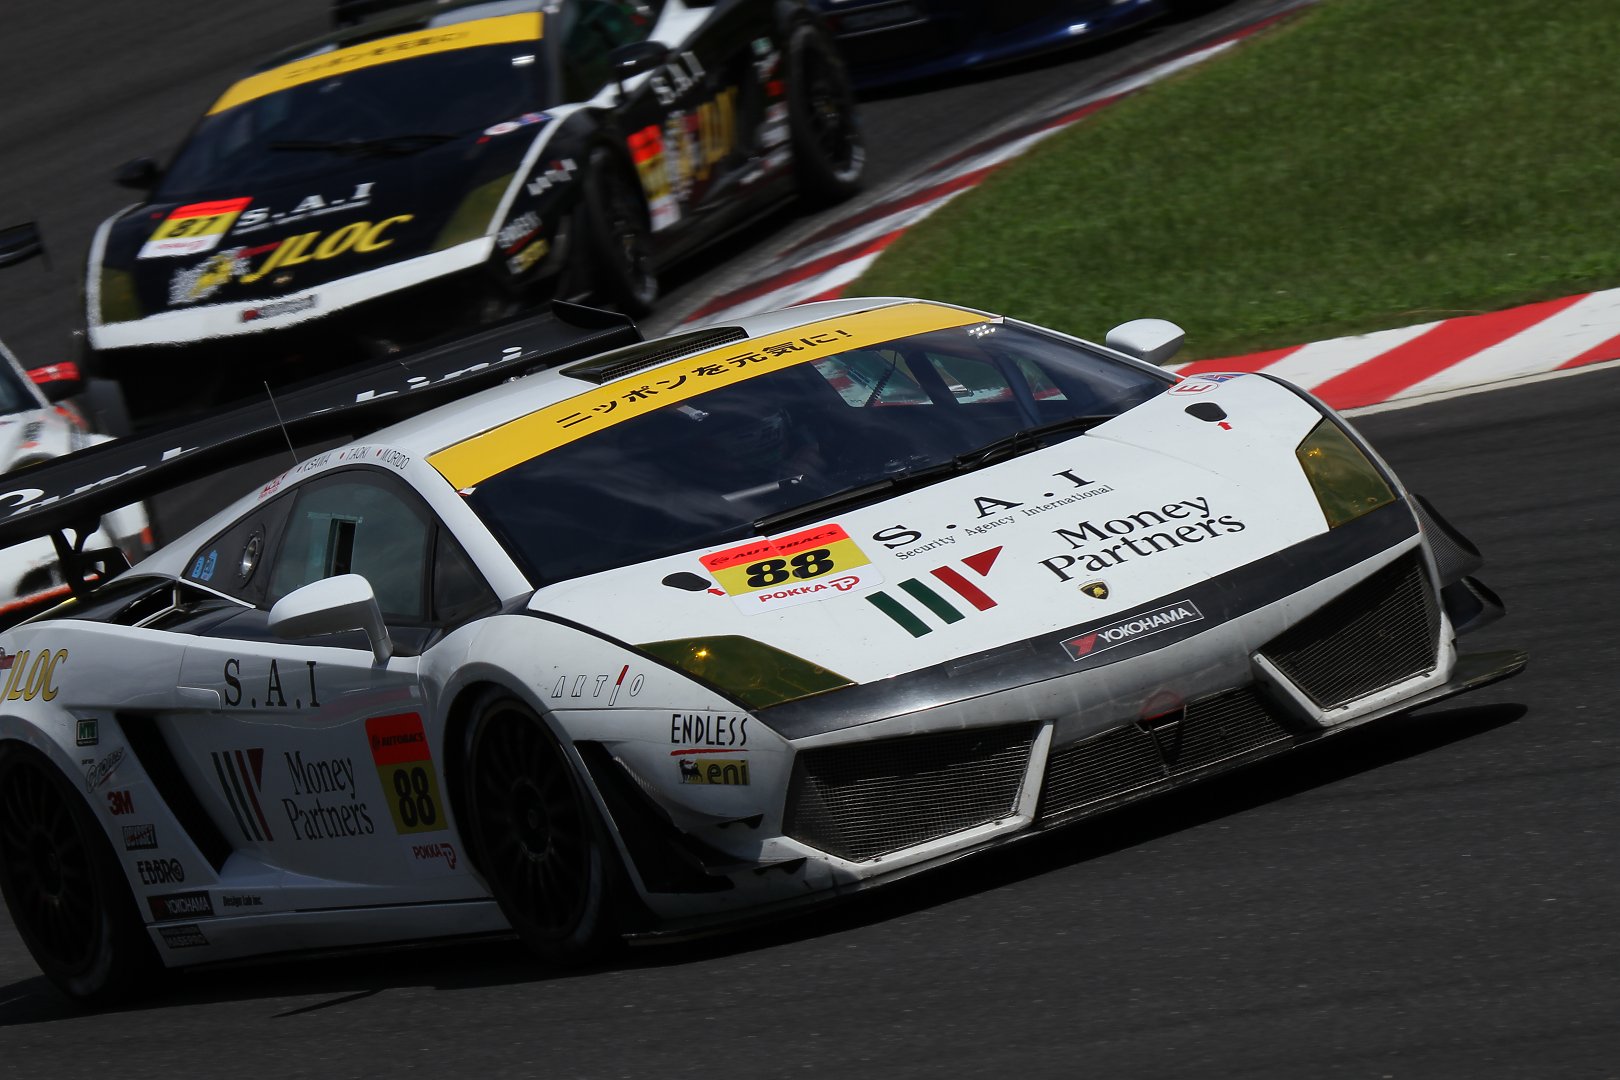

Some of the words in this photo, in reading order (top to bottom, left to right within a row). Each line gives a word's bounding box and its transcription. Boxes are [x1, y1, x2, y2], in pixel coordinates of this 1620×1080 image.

[239, 213, 415, 284] JLOC
[895, 533, 956, 561] Security
[964, 514, 1016, 537] Agency
[1021, 484, 1115, 518] International
[1052, 496, 1213, 551] Money
[730, 529, 838, 559] AUTOBACS
[1037, 512, 1247, 584] Partners
[745, 548, 835, 588] 88
[758, 583, 828, 603] POKKA
[1097, 606, 1195, 644] YOKOHAMA
[223, 658, 321, 710] S.A.I
[551, 664, 645, 707] AKTIO
[670, 713, 748, 747] ENDLESS
[284, 750, 356, 799] Money
[706, 759, 747, 785] eni
[106, 790, 135, 815] 3M
[393, 766, 436, 828] 88
[282, 798, 375, 841] Partners
[412, 843, 442, 860] POKKA
[166, 896, 211, 913] YOKOHAMA
